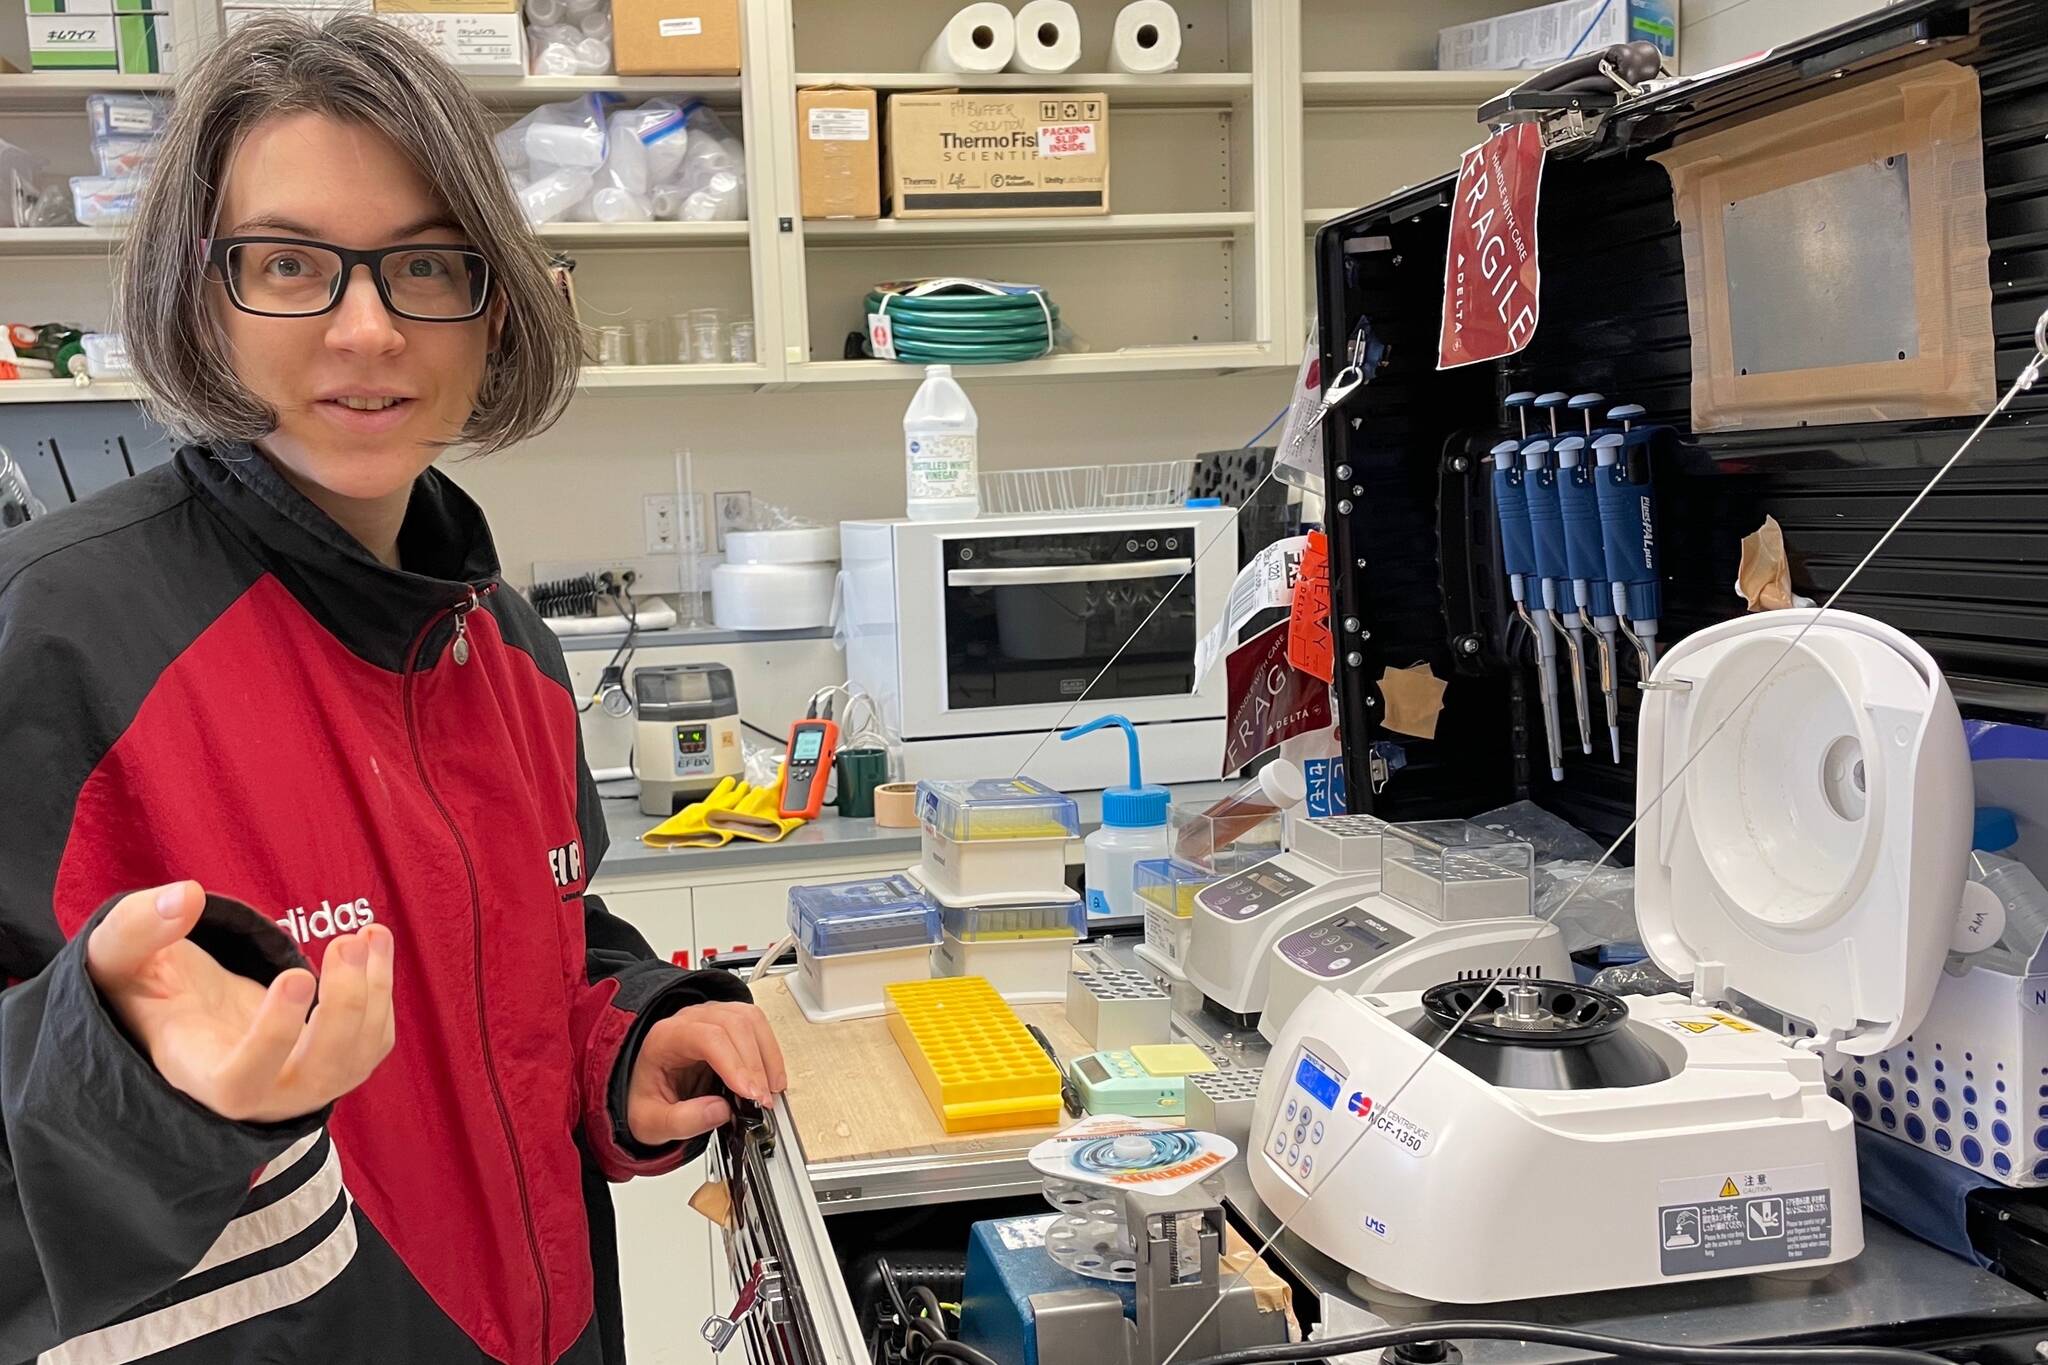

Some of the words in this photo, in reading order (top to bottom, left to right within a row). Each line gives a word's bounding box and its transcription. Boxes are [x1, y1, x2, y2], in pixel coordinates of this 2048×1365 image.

[1042, 125, 1091, 137] PACKING
[1054, 134, 1080, 144] SLIP
[1049, 142, 1086, 153] INSIDE
[1491, 153, 1508, 197] HANDLE
[1500, 194, 1516, 227] WITH
[1510, 227, 1528, 263] CARE
[1461, 149, 1535, 350] FRAGILE
[1454, 271, 1465, 334] DELTA
[1643, 548, 1653, 569] plus
[1295, 586, 1307, 622] DELTA
[1312, 563, 1330, 650] HEAVY
[1267, 634, 1286, 659] CARE
[1276, 708, 1309, 730] DELTA
[1309, 762, 1327, 812] セトモノ
[276, 897, 374, 943] didas
[1367, 1110, 1422, 1151] MCF-1350
[1387, 1108, 1430, 1141] CENTRIFUGE
[1743, 1173, 1767, 1187] 注意
[1743, 1186, 1772, 1194] CAUTION
[1365, 1215, 1386, 1235] LMS
